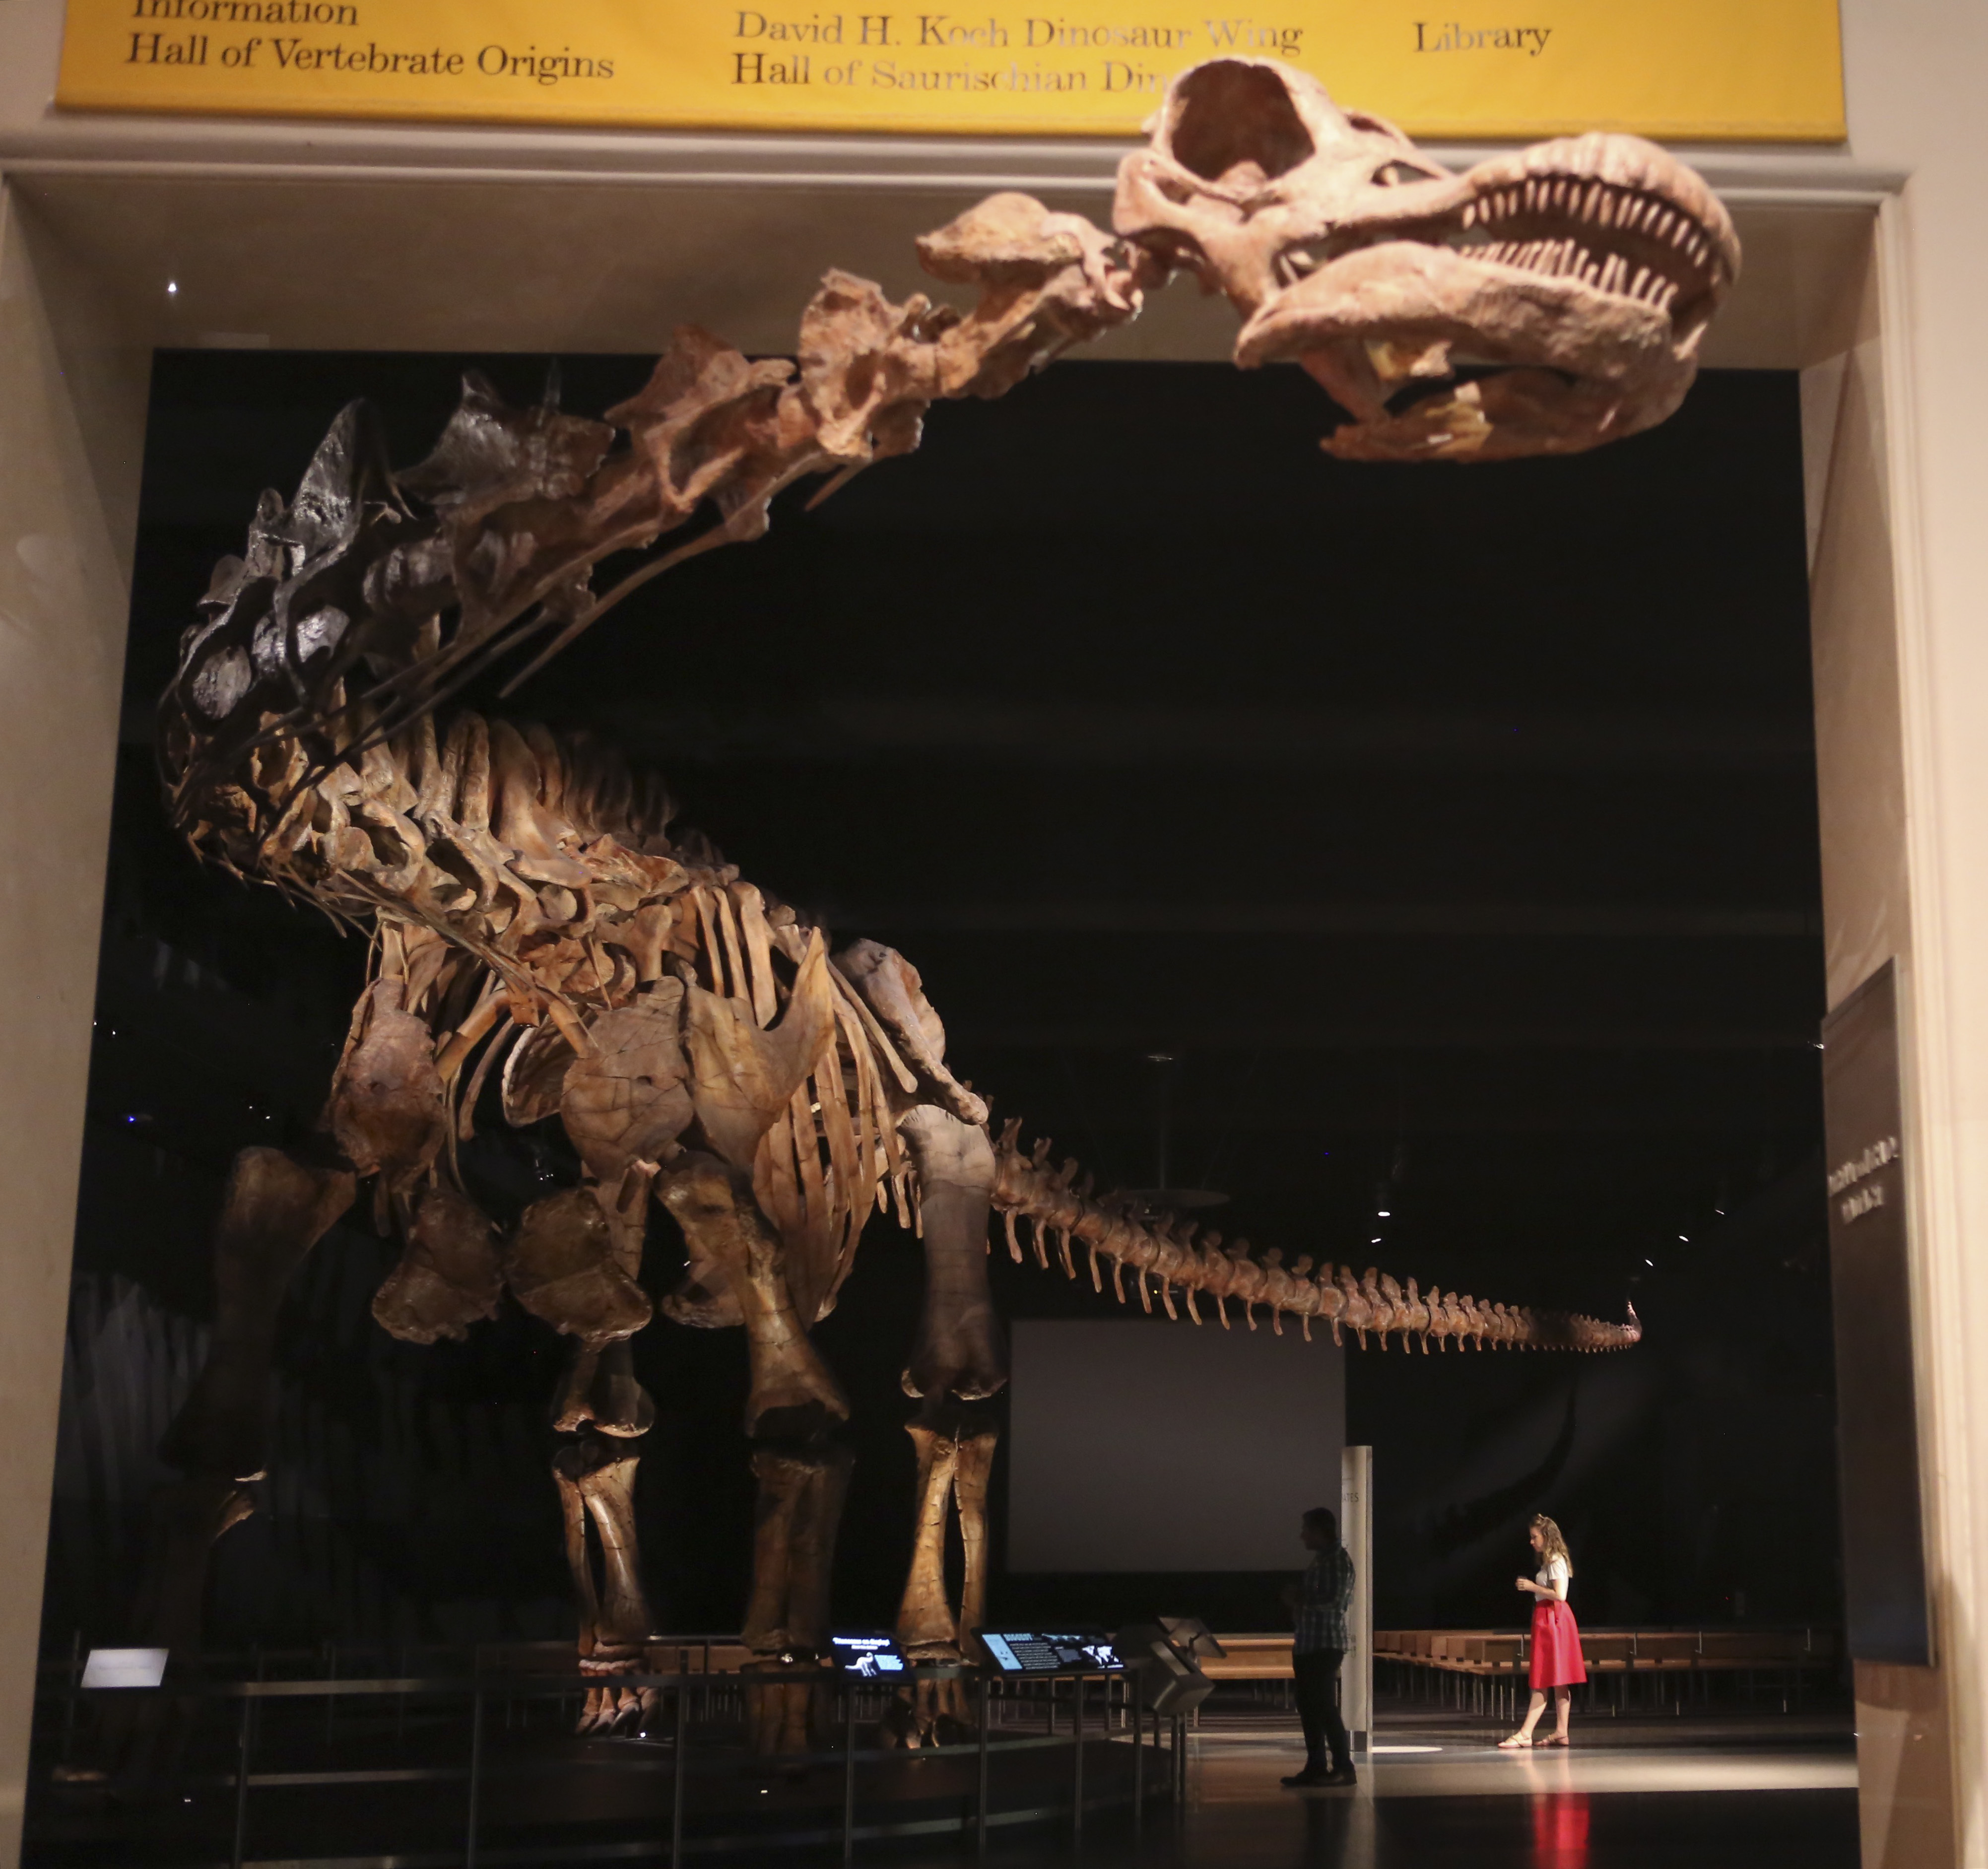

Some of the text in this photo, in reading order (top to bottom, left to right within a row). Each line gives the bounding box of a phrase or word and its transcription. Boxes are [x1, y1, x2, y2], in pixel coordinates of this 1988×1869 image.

[132, 0, 359, 26] Information
[734, 10, 1303, 57] David H. Koch Dinosaur Wing
[1412, 22, 1552, 57] Library
[125, 32, 615, 85] Hall of Vertebrate Origins
[731, 53, 1168, 93] Hall of Saurischian Din
